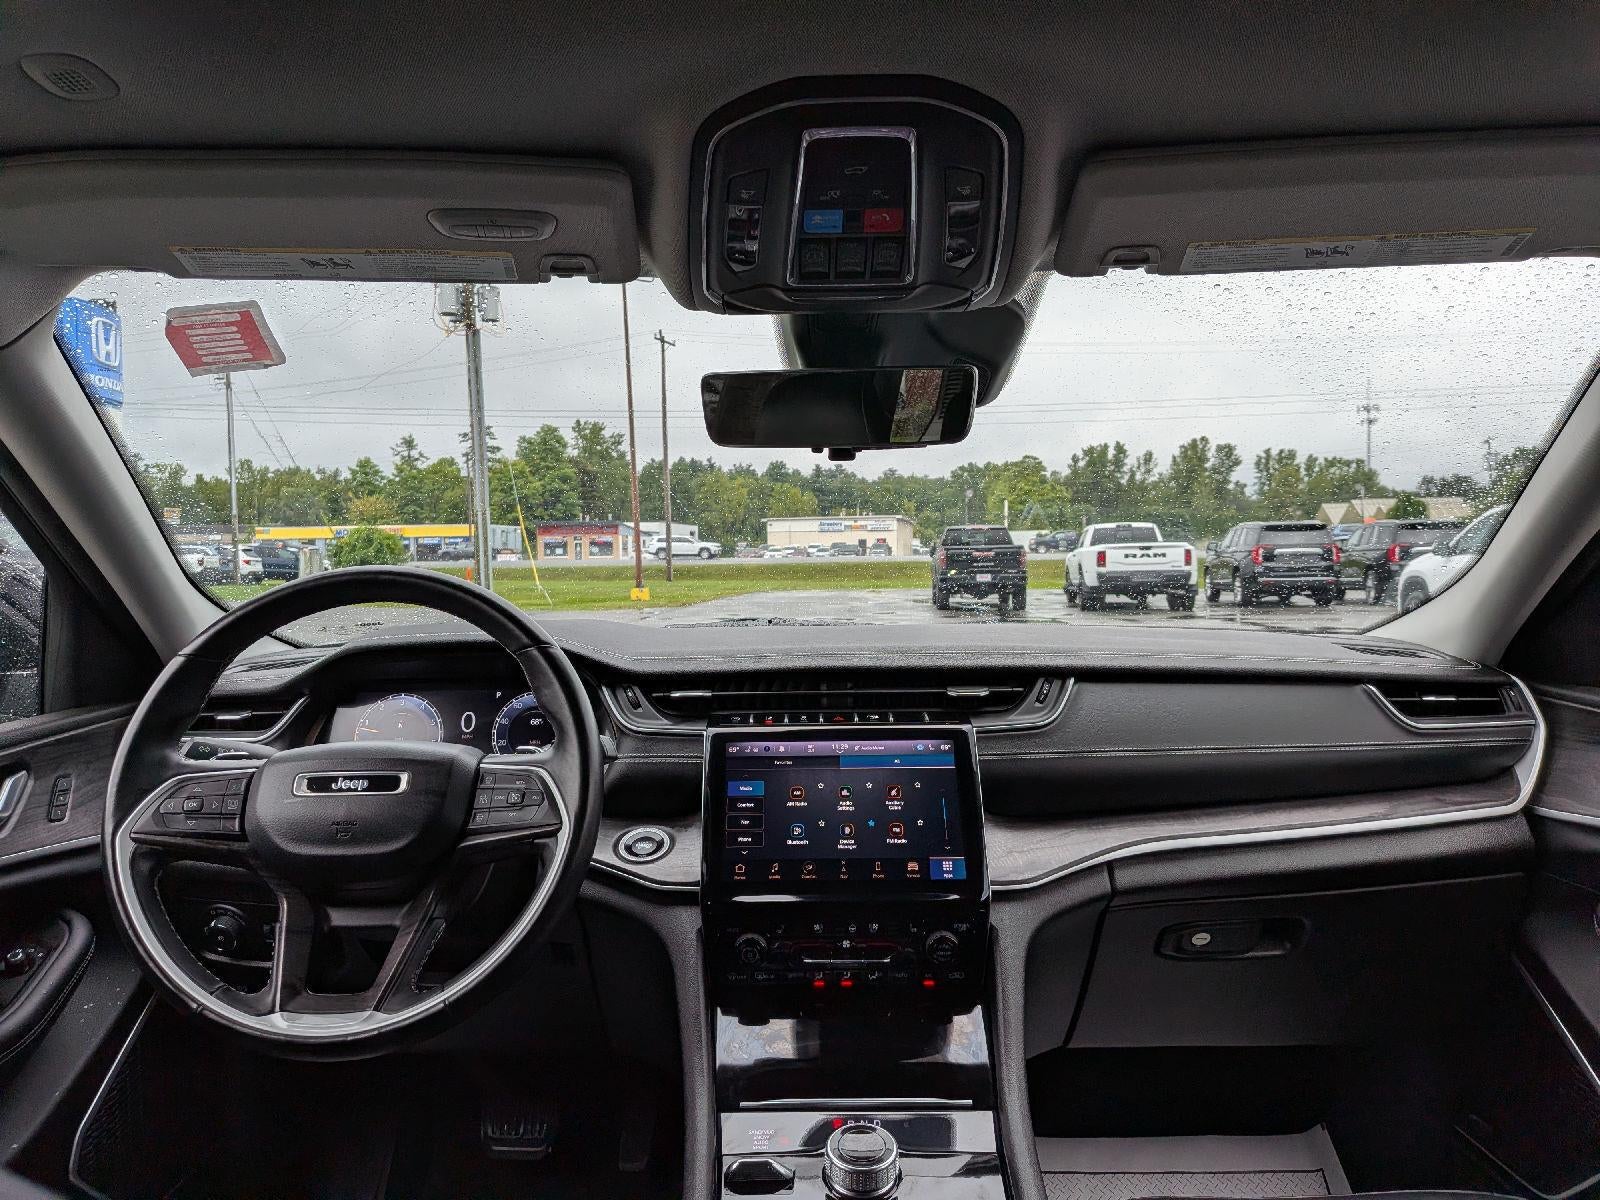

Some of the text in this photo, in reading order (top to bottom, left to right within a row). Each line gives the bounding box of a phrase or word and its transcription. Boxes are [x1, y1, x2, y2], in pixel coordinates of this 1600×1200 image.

[460, 711, 477, 733] 0
[500, 717, 509, 725] 40
[497, 739, 507, 747] 20
[331, 776, 370, 791] Jeep
